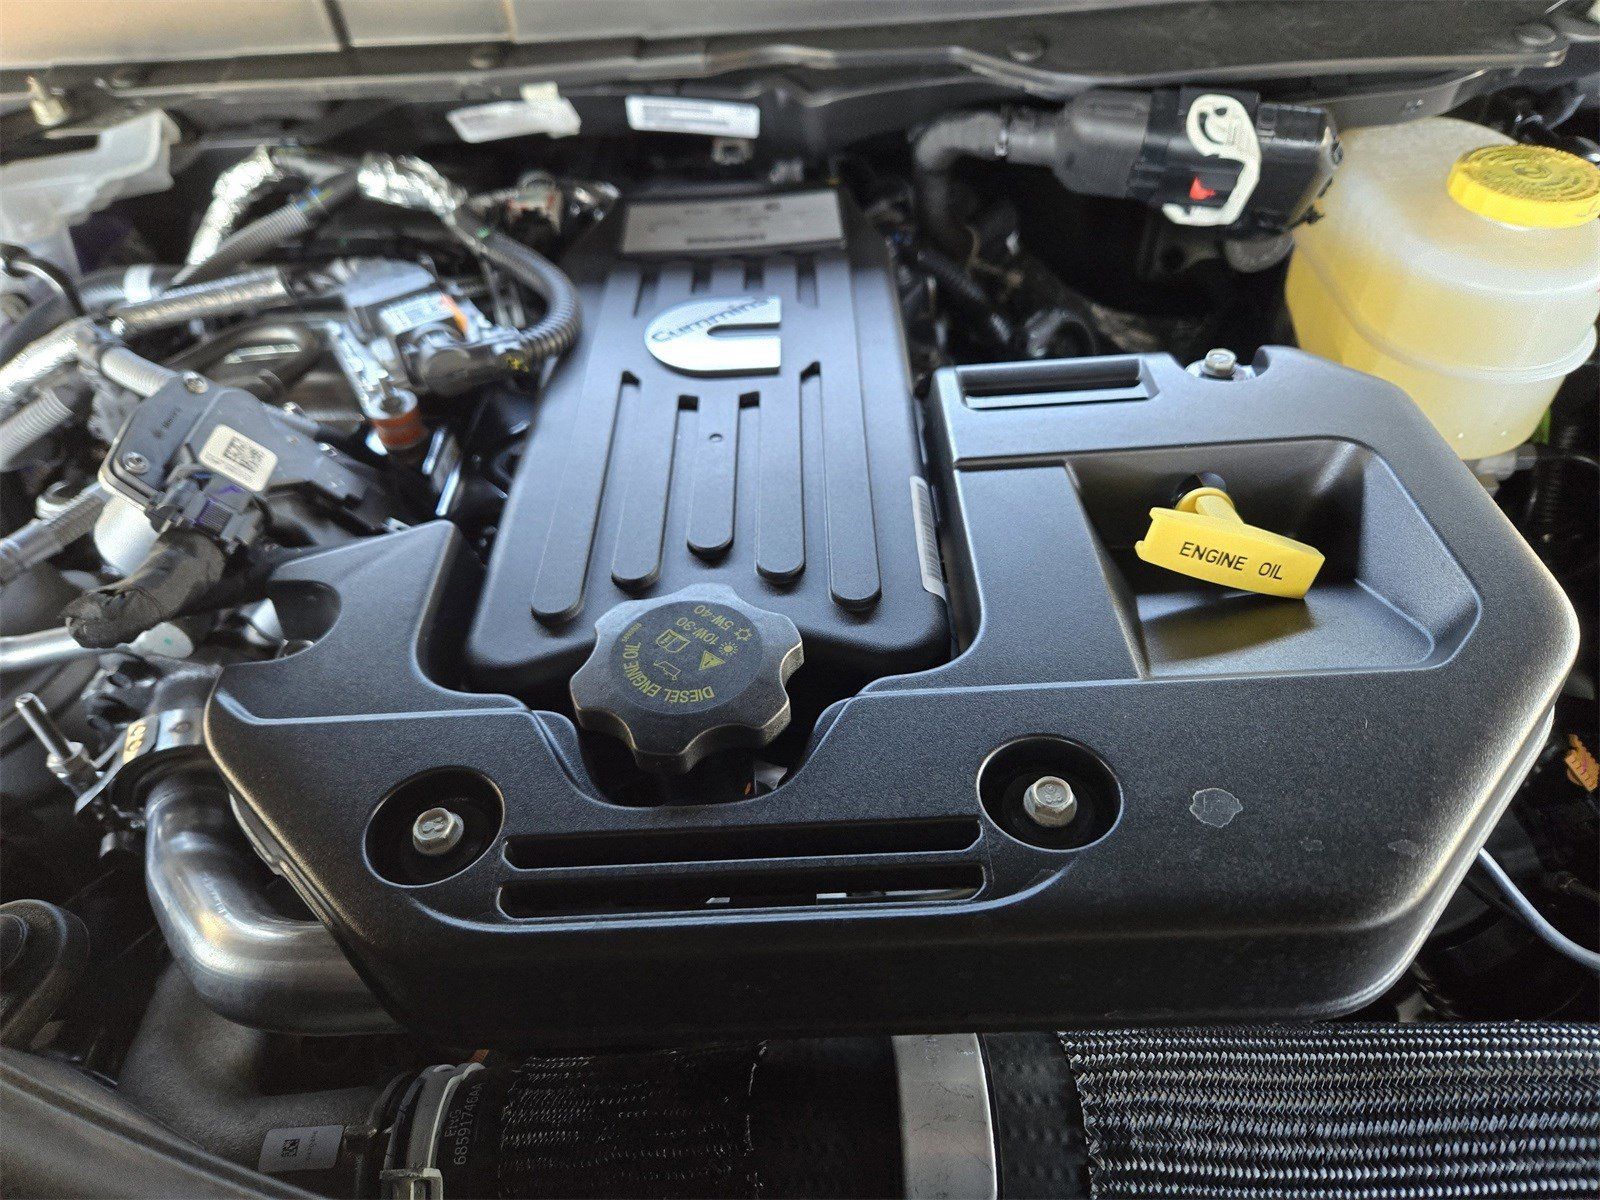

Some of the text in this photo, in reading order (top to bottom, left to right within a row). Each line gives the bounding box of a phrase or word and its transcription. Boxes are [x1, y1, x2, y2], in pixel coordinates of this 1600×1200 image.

[1179, 541, 1283, 580] ENGINE OIL
[676, 617, 720, 644] 10W-30
[693, 604, 734, 631] 5W-40
[622, 641, 715, 703] DIESEL ENGINE OIL
